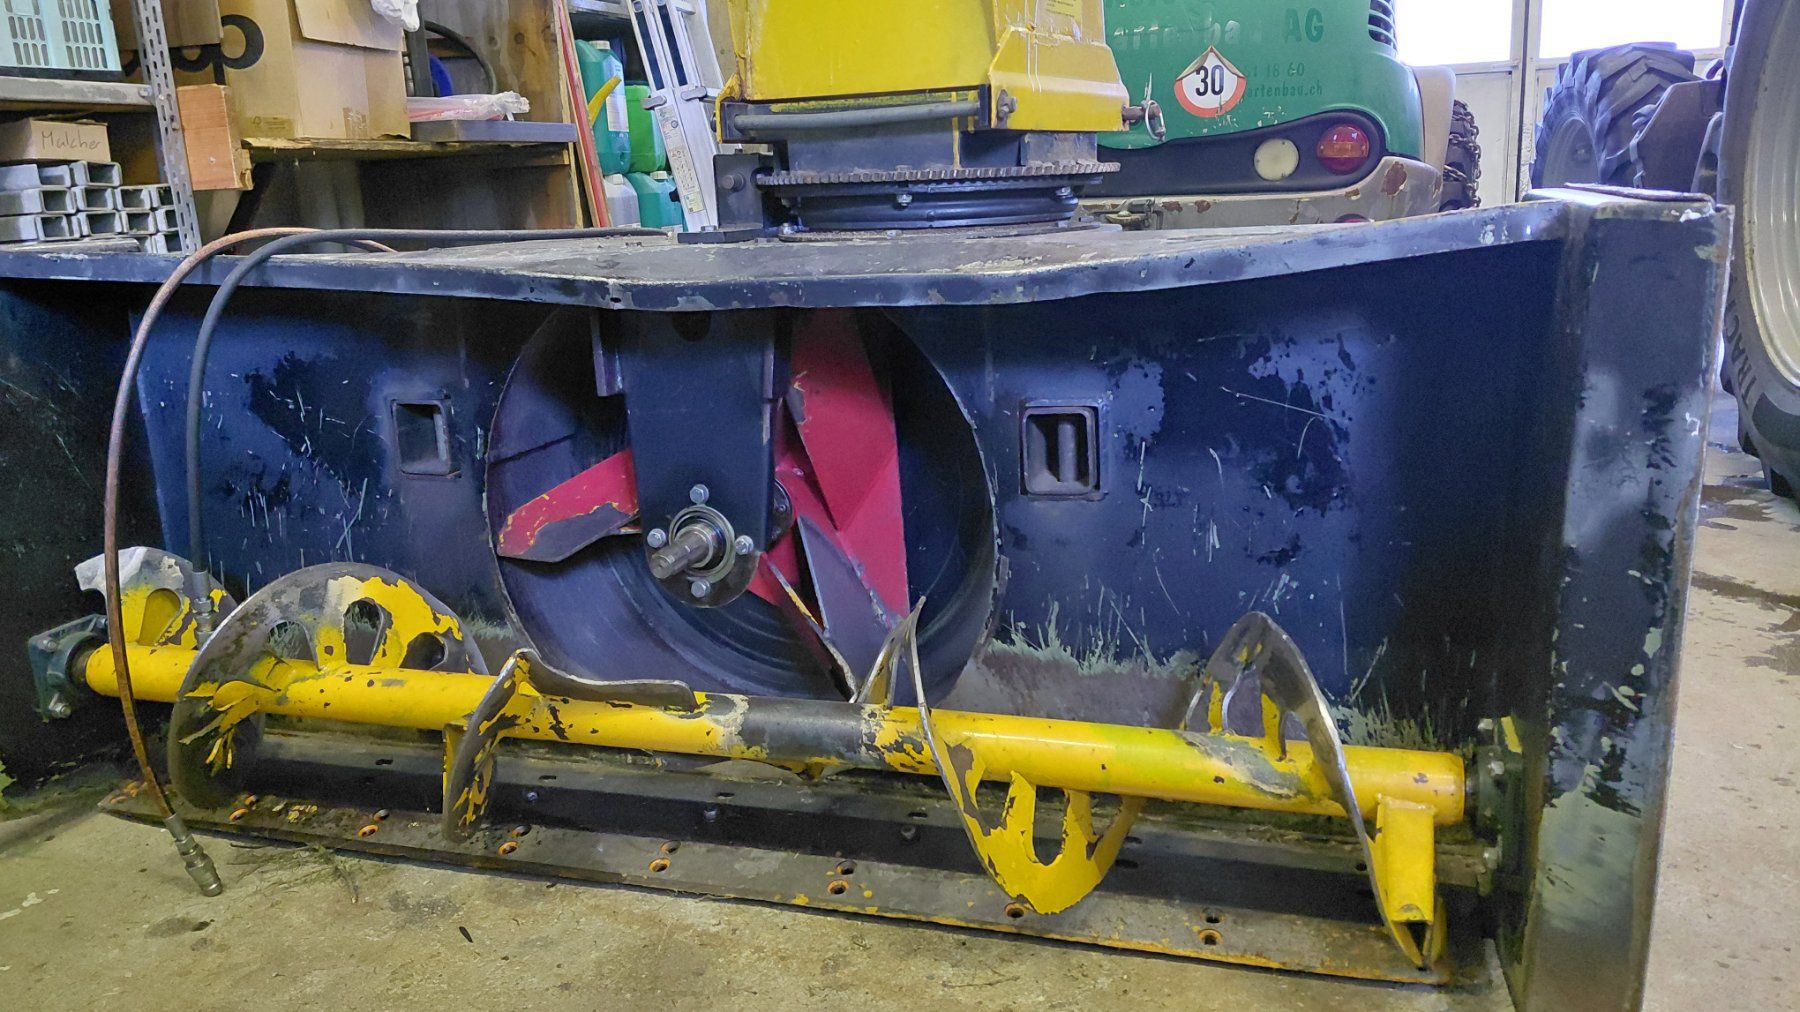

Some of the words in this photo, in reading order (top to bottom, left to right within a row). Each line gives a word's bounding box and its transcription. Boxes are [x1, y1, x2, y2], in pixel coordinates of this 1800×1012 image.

[1284, 7, 1324, 43] AG
[1195, 64, 1225, 96] 30
[1245, 79, 1323, 98] artenbau.ch
